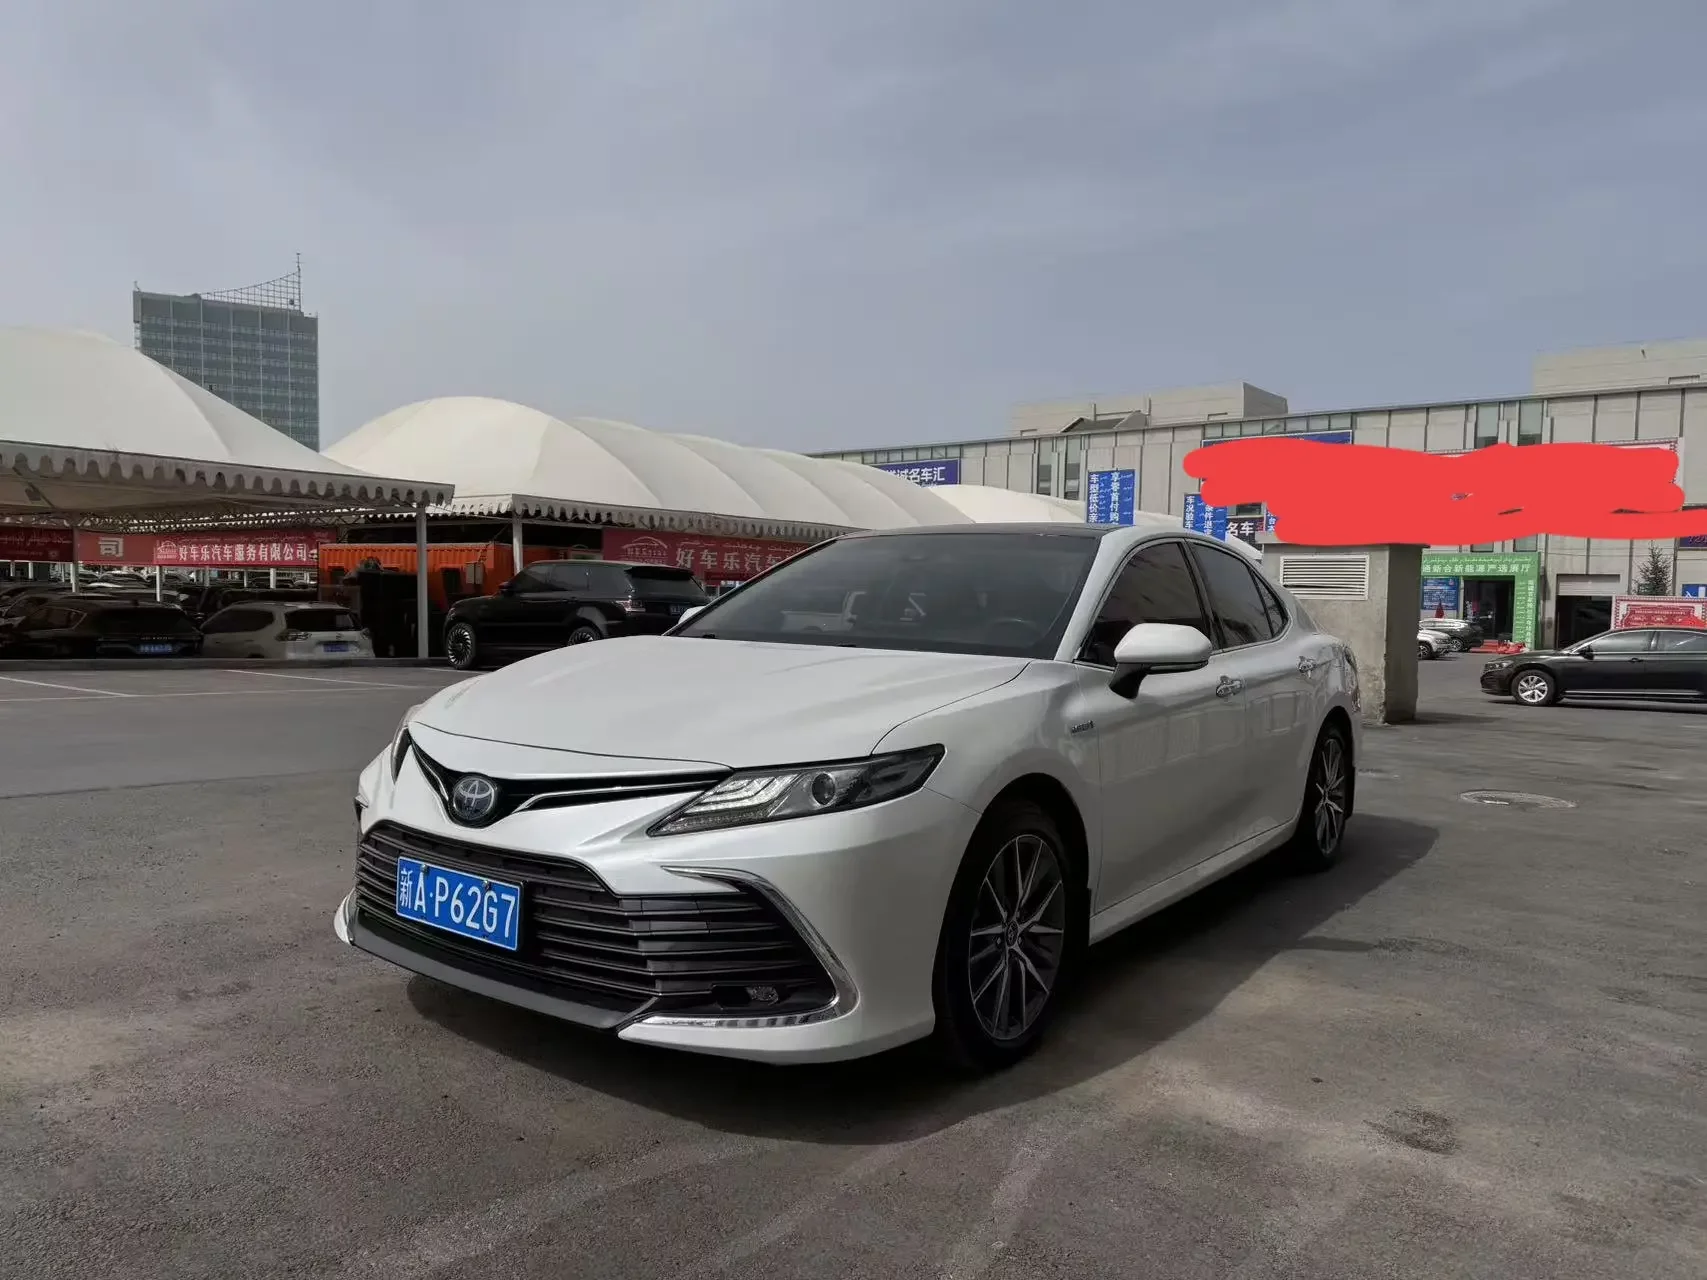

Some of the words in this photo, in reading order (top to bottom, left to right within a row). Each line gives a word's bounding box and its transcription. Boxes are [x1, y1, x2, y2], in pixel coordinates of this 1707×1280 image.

[98, 536, 124, 557] 司
[178, 542, 307, 562] 好车乐汽车服务有限公司
[676, 547, 792, 573] 好车乐汽车
